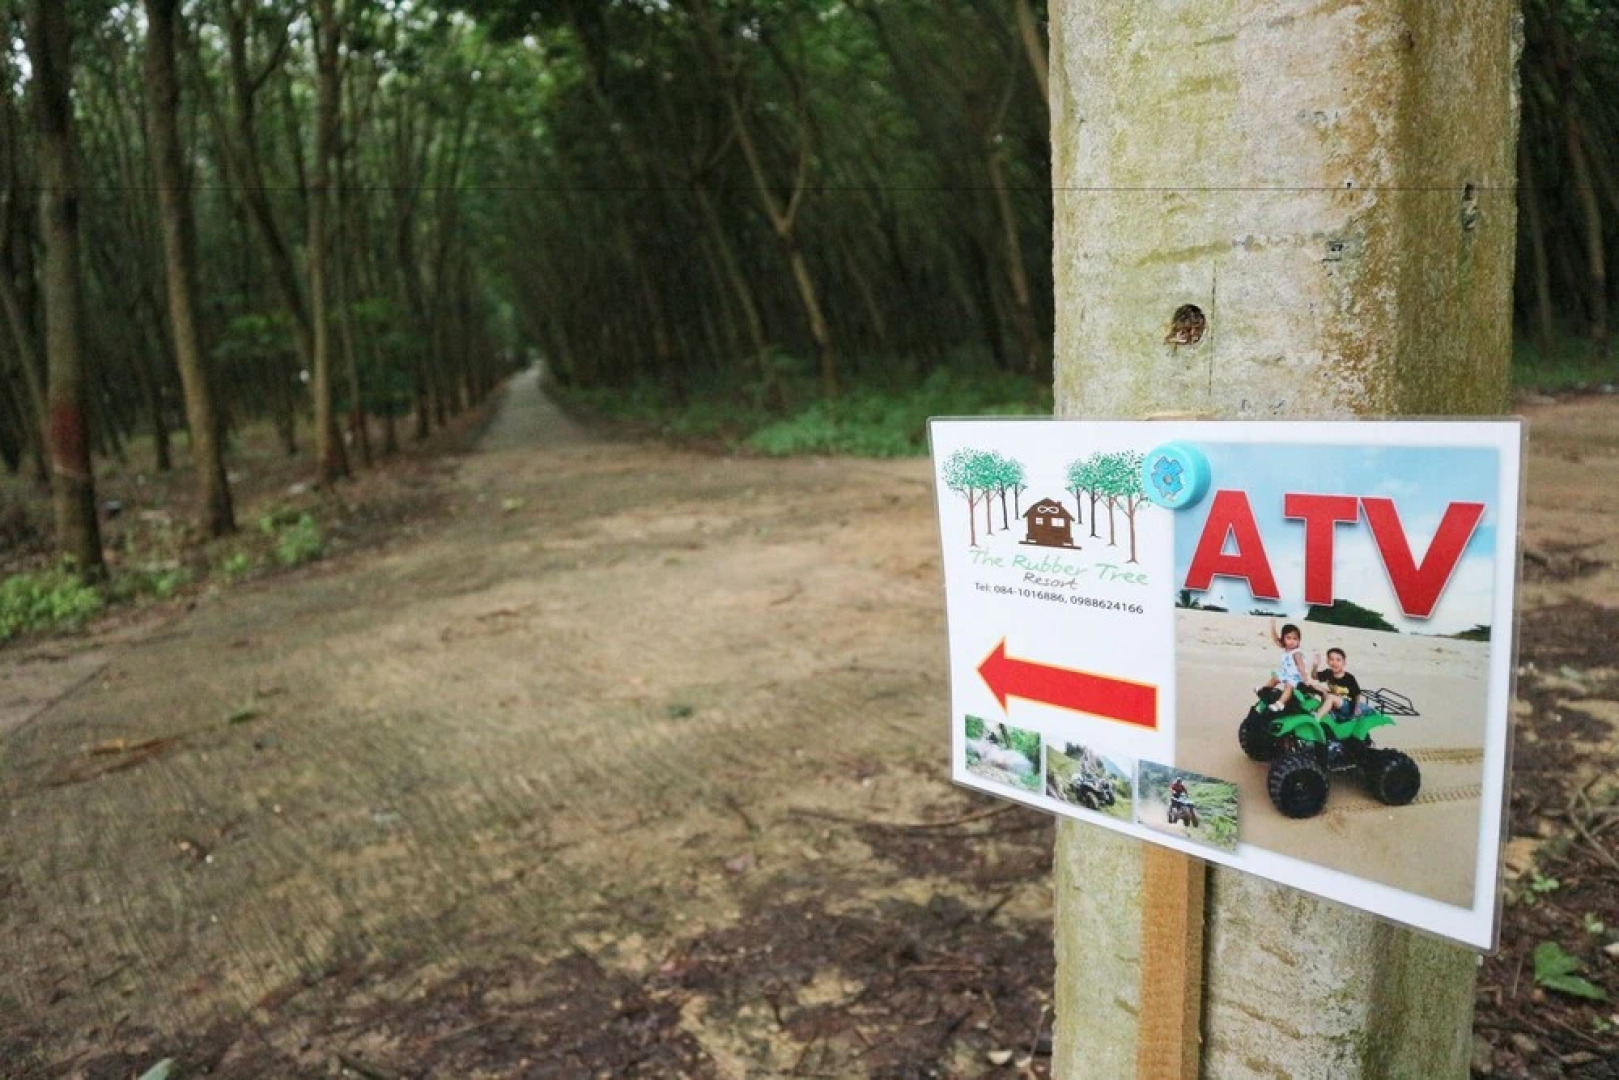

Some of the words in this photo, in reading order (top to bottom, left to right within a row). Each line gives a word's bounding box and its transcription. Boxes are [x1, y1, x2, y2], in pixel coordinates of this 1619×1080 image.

[970, 548, 1004, 568] The
[1012, 554, 1088, 576] Rubber
[1095, 562, 1149, 586] Tree
[1184, 489, 1486, 619] ATV
[975, 582, 990, 592] Tel:
[993, 586, 1067, 604] 084-1016886,
[1070, 595, 1144, 614] 0988624166
[1023, 571, 1078, 590] Resort
